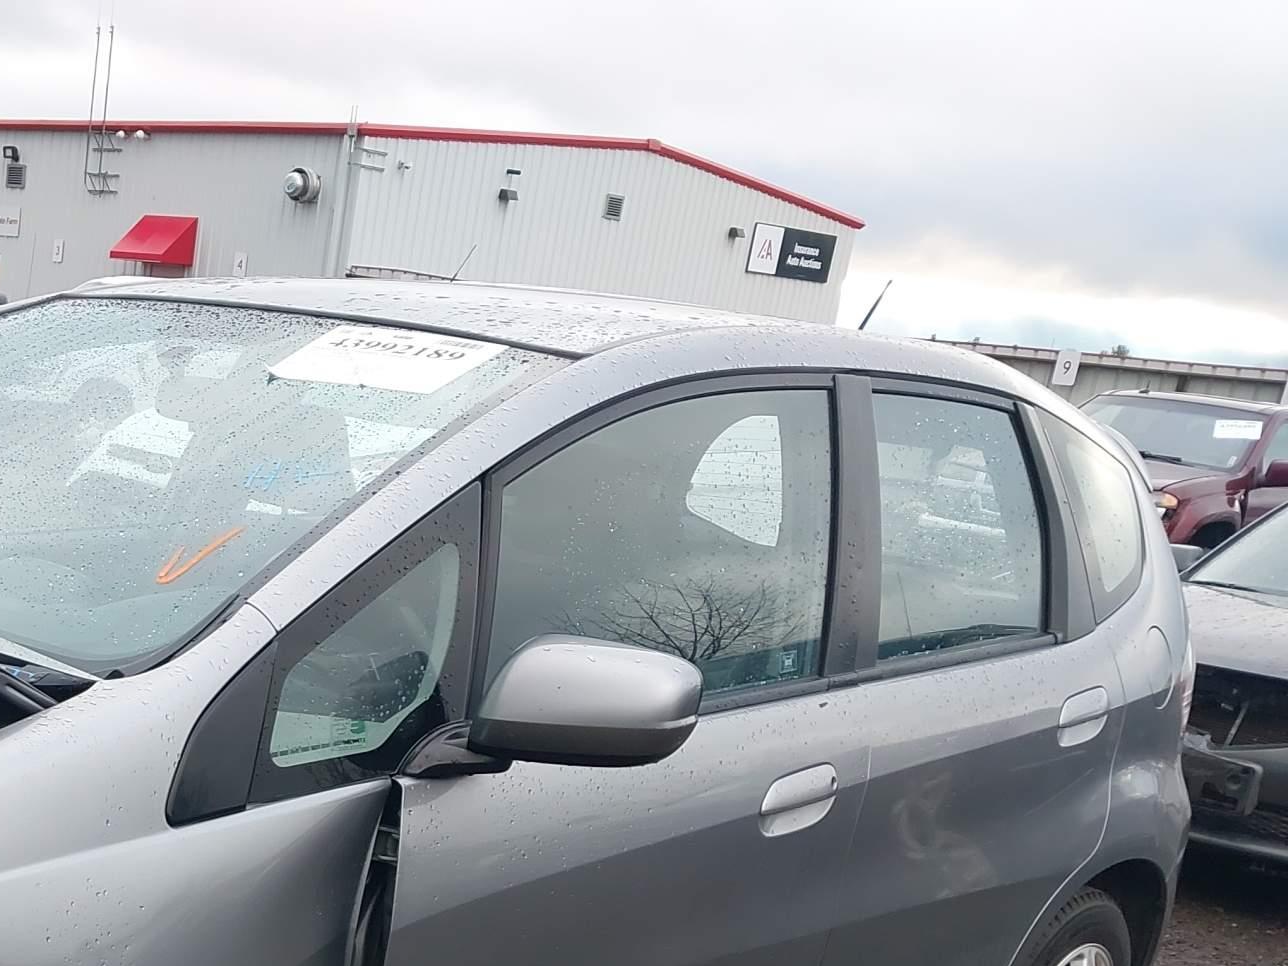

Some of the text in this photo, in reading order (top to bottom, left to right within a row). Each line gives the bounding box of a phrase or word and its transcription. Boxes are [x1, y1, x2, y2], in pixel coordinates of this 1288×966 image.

[55, 245, 60, 256] 3
[237, 259, 243, 269] 4
[329, 338, 465, 360] 43992189
[1063, 360, 1072, 375] 9
